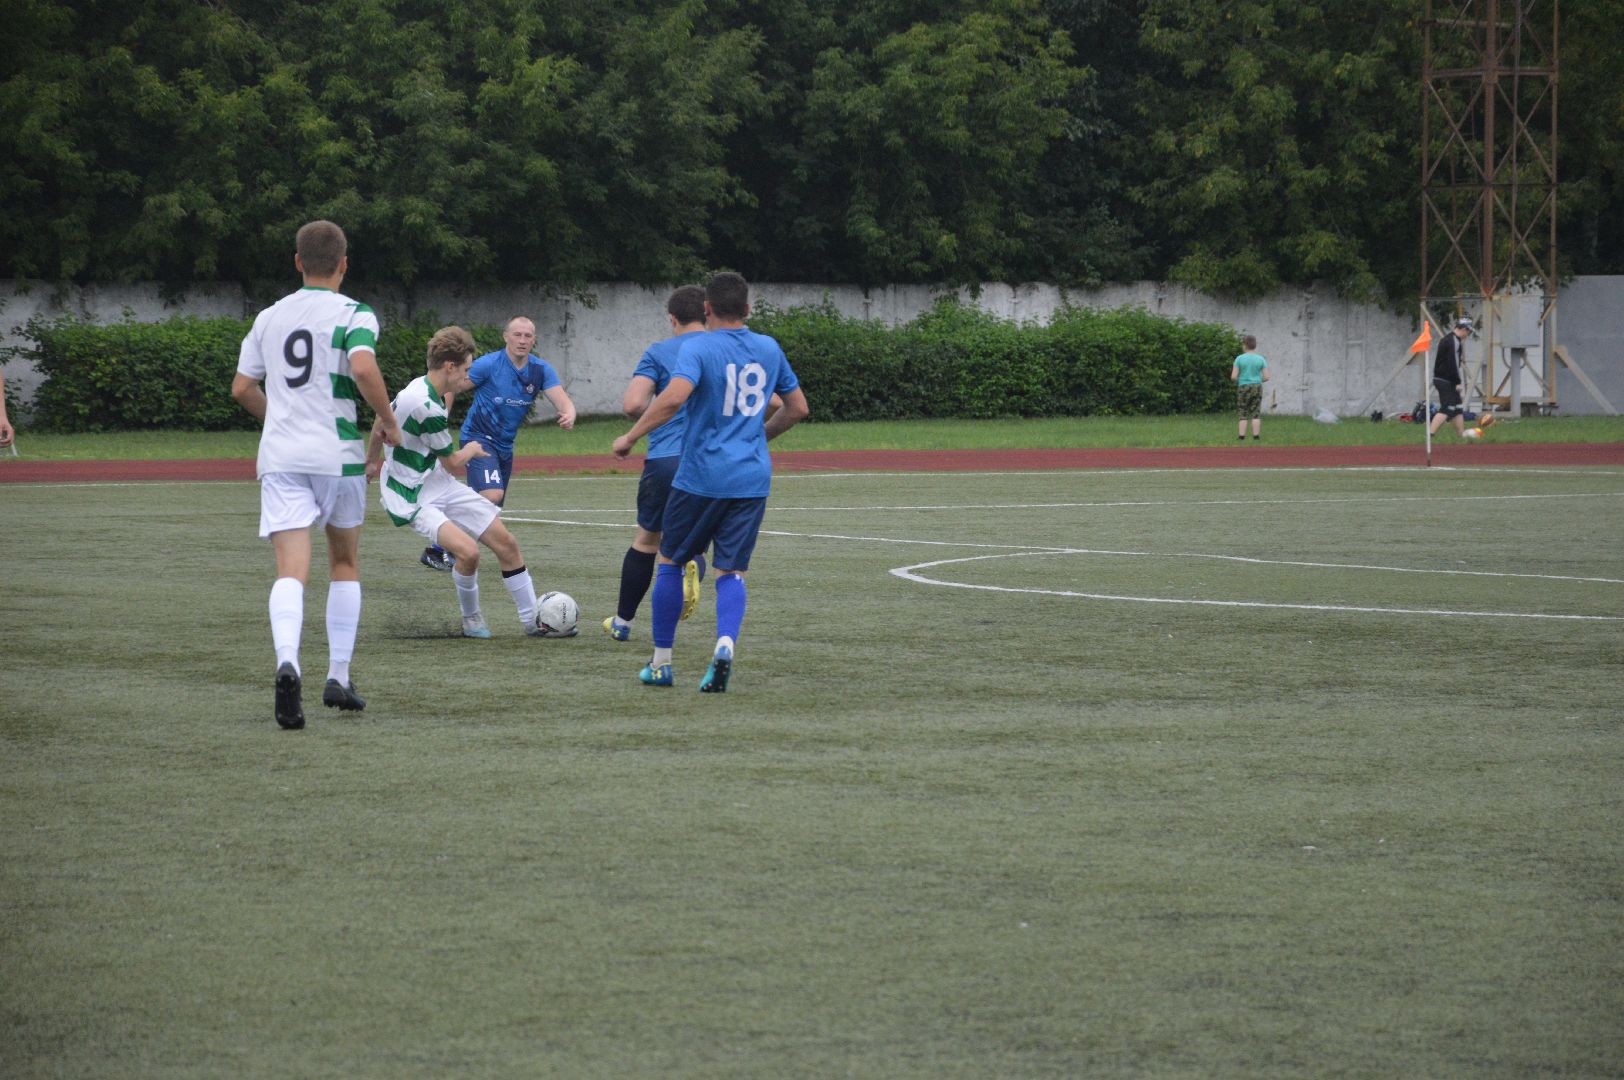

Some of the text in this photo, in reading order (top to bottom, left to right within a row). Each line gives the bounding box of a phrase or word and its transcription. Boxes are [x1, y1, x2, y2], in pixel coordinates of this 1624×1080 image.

[284, 329, 313, 388] 9
[722, 362, 767, 417] 18
[484, 469, 501, 484] 14
